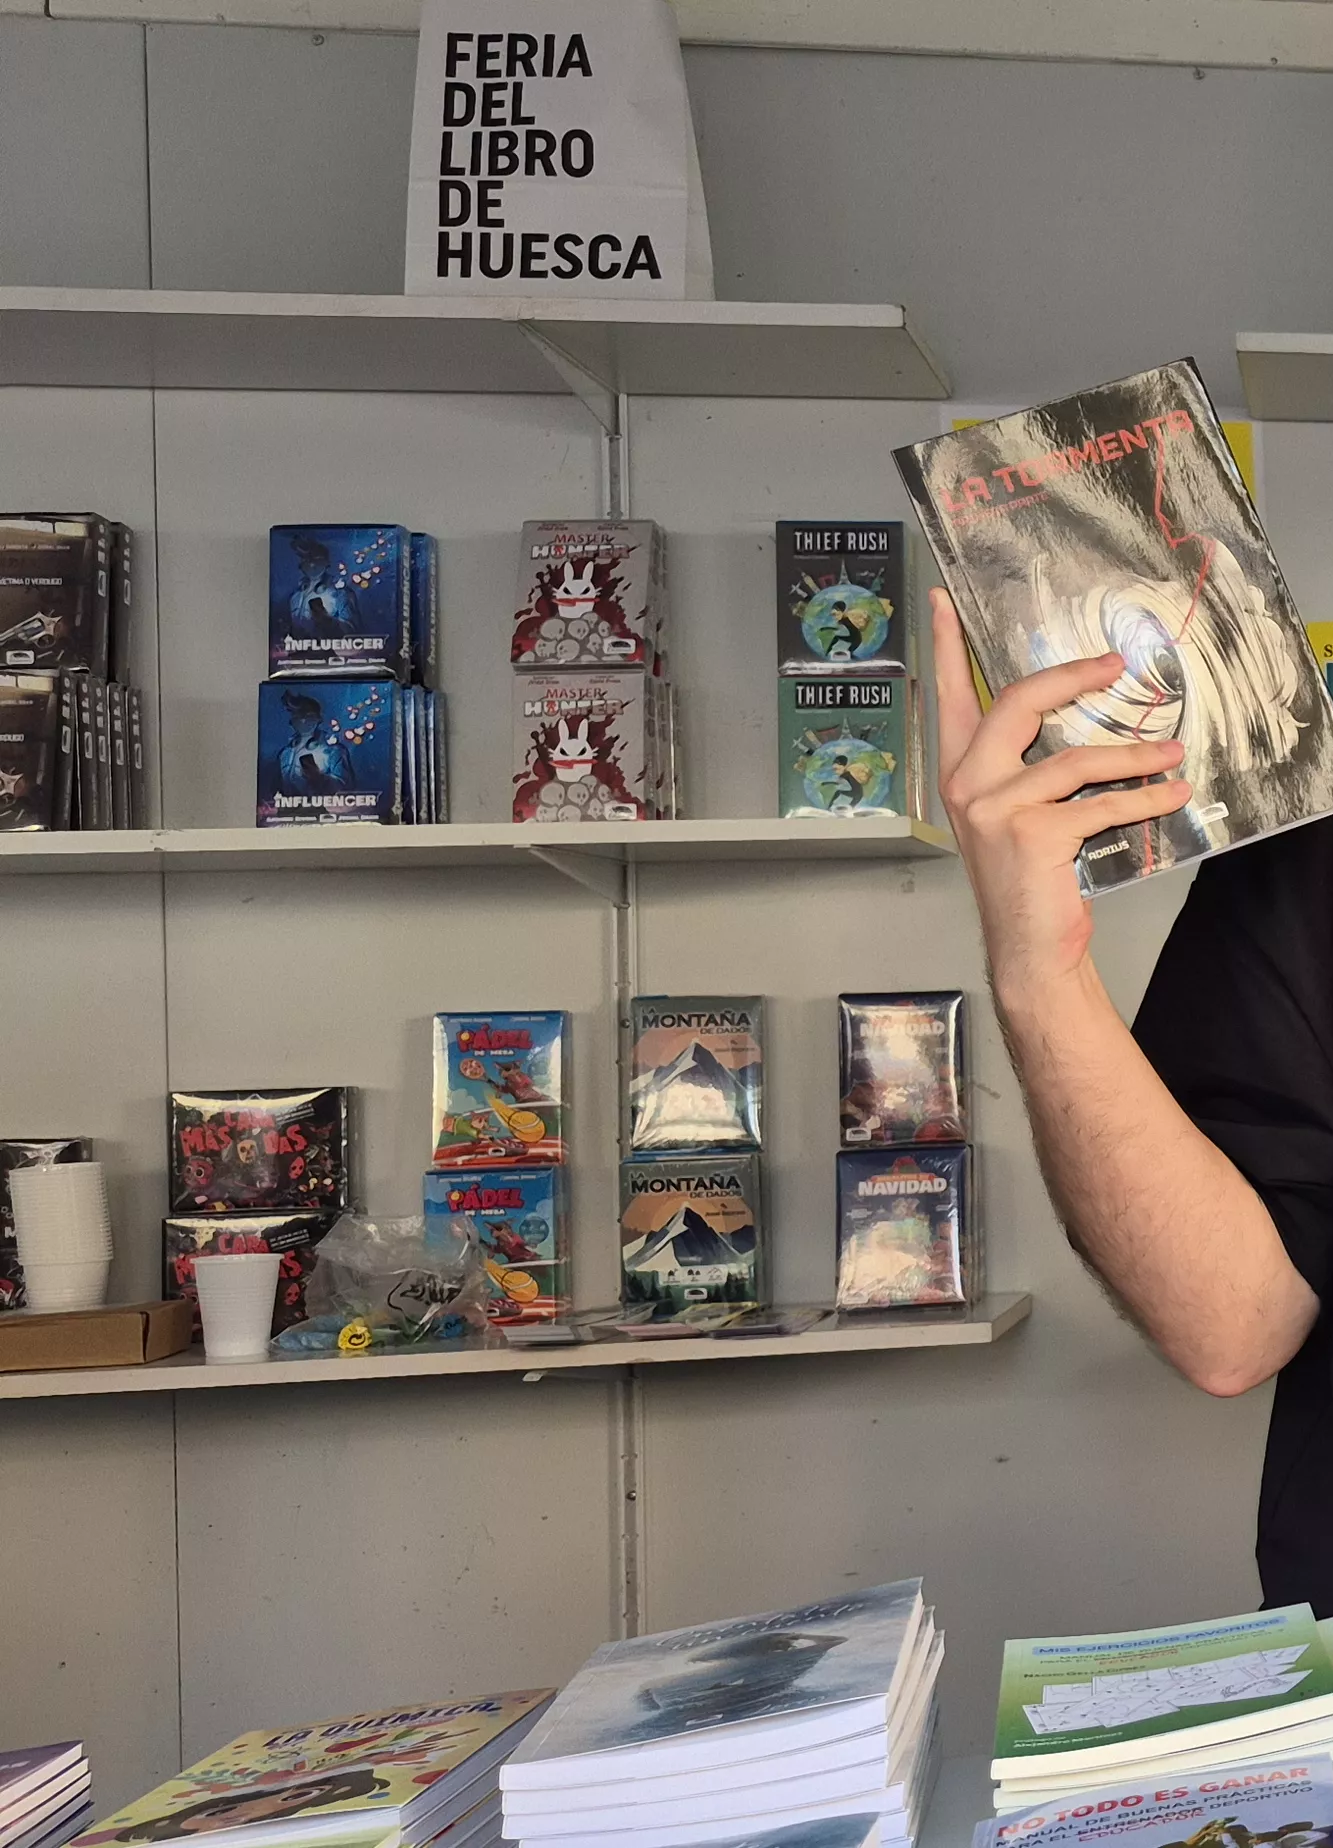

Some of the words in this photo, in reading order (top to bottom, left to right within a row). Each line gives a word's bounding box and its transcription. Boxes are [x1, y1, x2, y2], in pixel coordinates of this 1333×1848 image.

[445, 32, 593, 78] FERIA
[443, 82, 536, 127] DEL
[439, 129, 594, 178] LIBRO
[437, 180, 506, 229] DE
[437, 233, 662, 281] HUESCA
[940, 475, 992, 513] LA
[992, 409, 1195, 494] TORMENTA
[553, 533, 610, 544] MASTER
[794, 531, 842, 551] THIEF
[847, 531, 889, 551] RUSH
[283, 633, 388, 652] INFLUENCER
[545, 687, 602, 699] MASTER
[796, 685, 844, 706] THIEF
[848, 685, 892, 706] RUSH
[273, 790, 377, 809] INFLUENCER
[1087, 840, 1130, 861] ADRIUS
[641, 1008, 752, 1029] MONTAÑA
[456, 1022, 534, 1052] PÁDEL
[700, 1027, 715, 1035] DE
[716, 1026, 753, 1035] DADOS
[630, 1173, 742, 1195] MONTAÑA
[689, 1190, 705, 1199] DE
[705, 1189, 742, 1198] DADOS
[858, 1177, 948, 1197] NAVIDAD
[446, 1182, 525, 1212] PÁDEL
[996, 1816, 1047, 1839] NO
[1054, 1794, 1144, 1823] TODO
[1154, 1785, 1189, 1802] ES
[1199, 1766, 1310, 1794] GANAR
[1208, 1785, 1314, 1811] DEPORTIVO
[1085, 1815, 1104, 1825] DE
[1110, 1800, 1199, 1822] BUENAS
[1078, 1810, 1207, 1843] EDUCADOR
